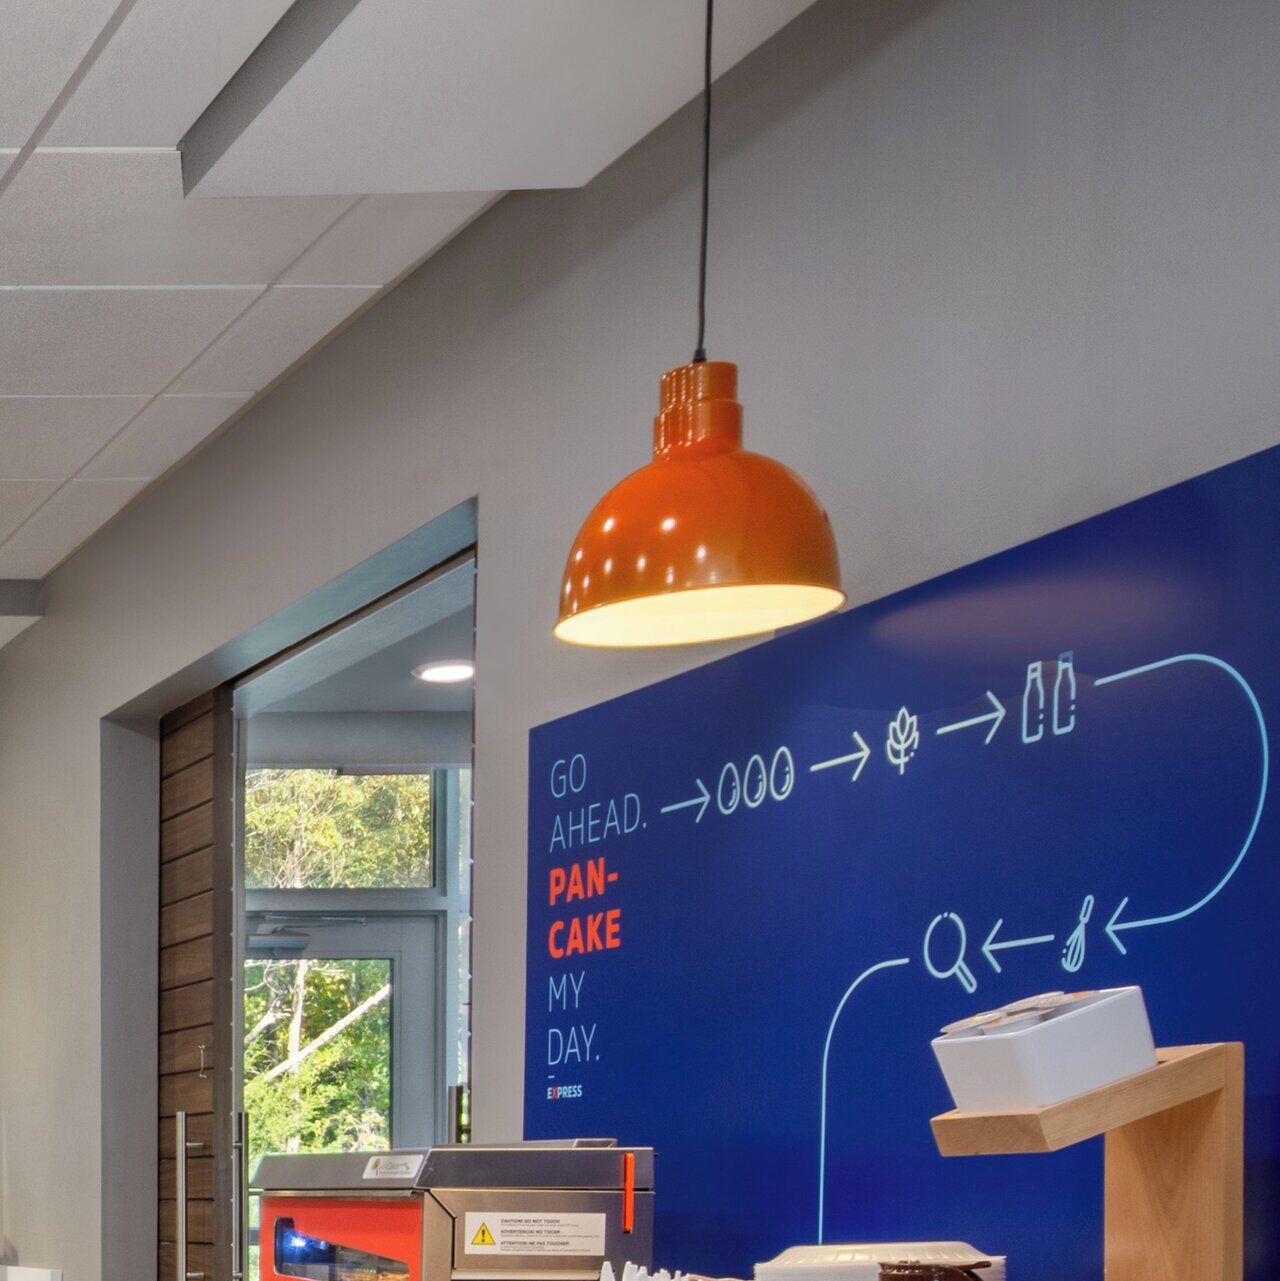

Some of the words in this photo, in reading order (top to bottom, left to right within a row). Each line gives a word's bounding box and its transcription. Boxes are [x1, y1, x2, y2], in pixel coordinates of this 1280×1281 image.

[550, 753, 587, 798] GO
[549, 793, 647, 853] AHEAD.
[549, 857, 619, 906] PAN-
[548, 909, 621, 959] CAKE
[548, 970, 586, 1013] MY
[547, 1023, 600, 1066] DAY.
[547, 1084, 582, 1100] EXPRESS
